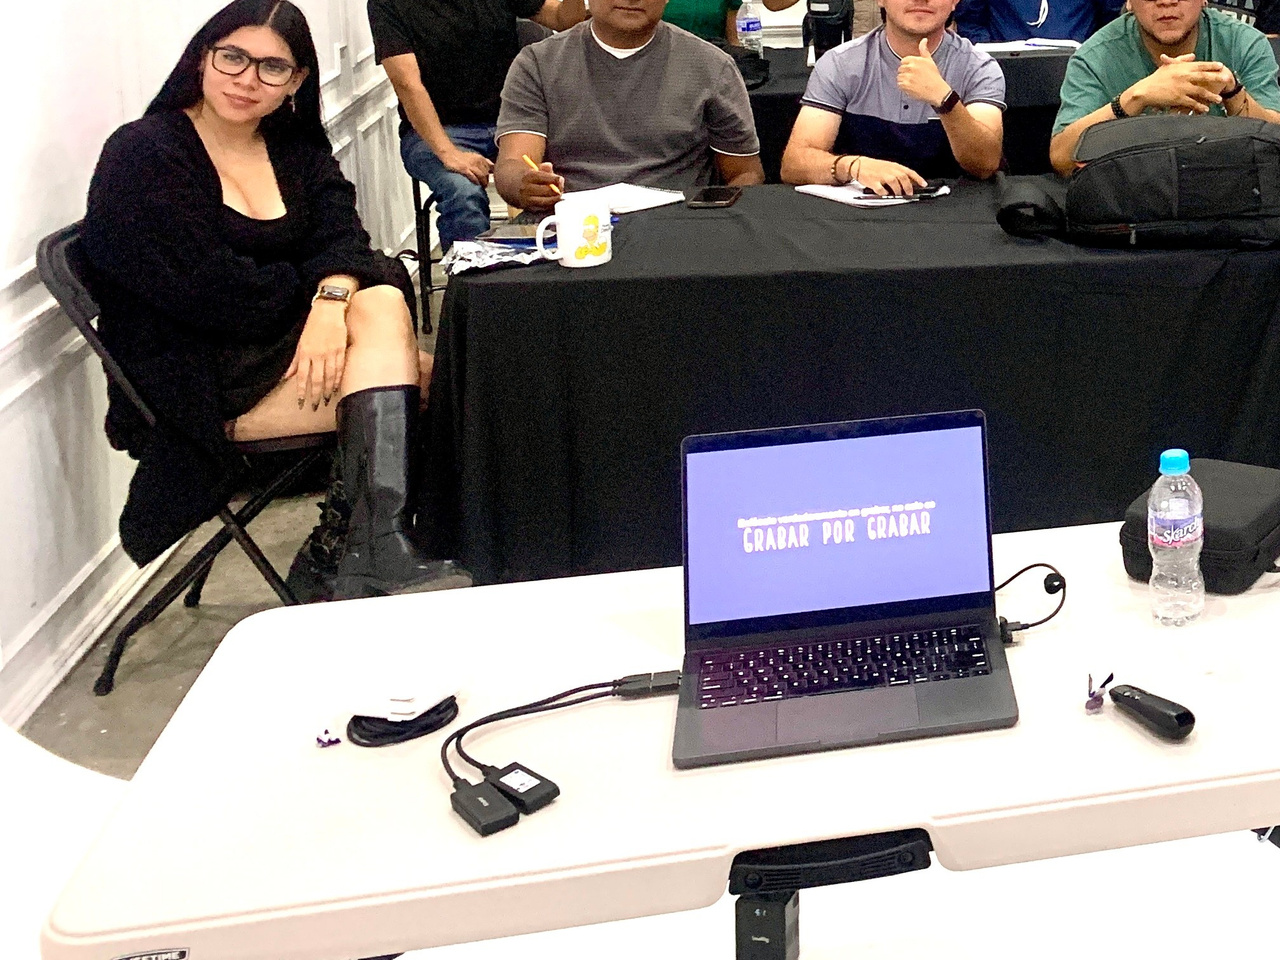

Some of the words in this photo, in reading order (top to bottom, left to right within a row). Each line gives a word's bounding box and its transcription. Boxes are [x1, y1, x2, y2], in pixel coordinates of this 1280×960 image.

[743, 524, 810, 553] GRABAR
[822, 519, 855, 545] POR
[867, 511, 931, 540] GRABAR
